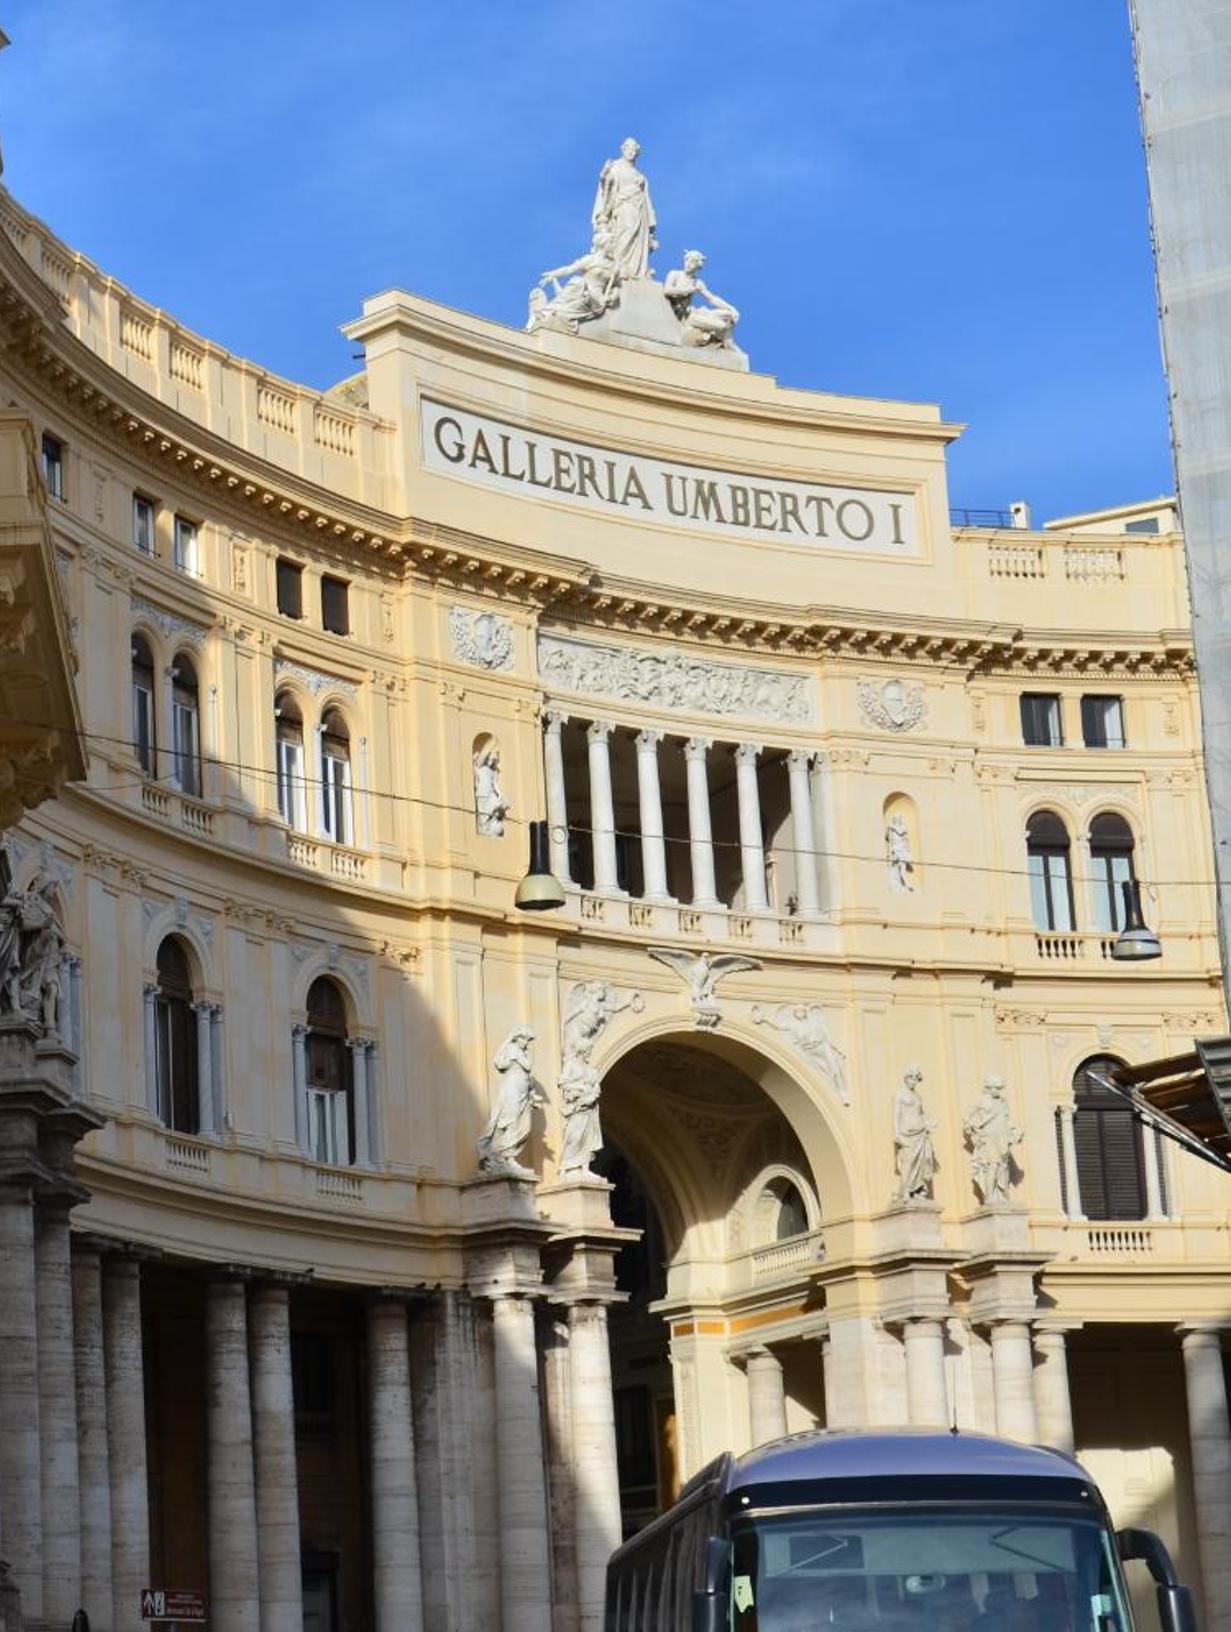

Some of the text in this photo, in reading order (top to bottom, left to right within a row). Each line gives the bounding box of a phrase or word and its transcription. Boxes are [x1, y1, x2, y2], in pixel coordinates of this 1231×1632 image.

[434, 416, 905, 544] GALLERIA UMBERTO I
